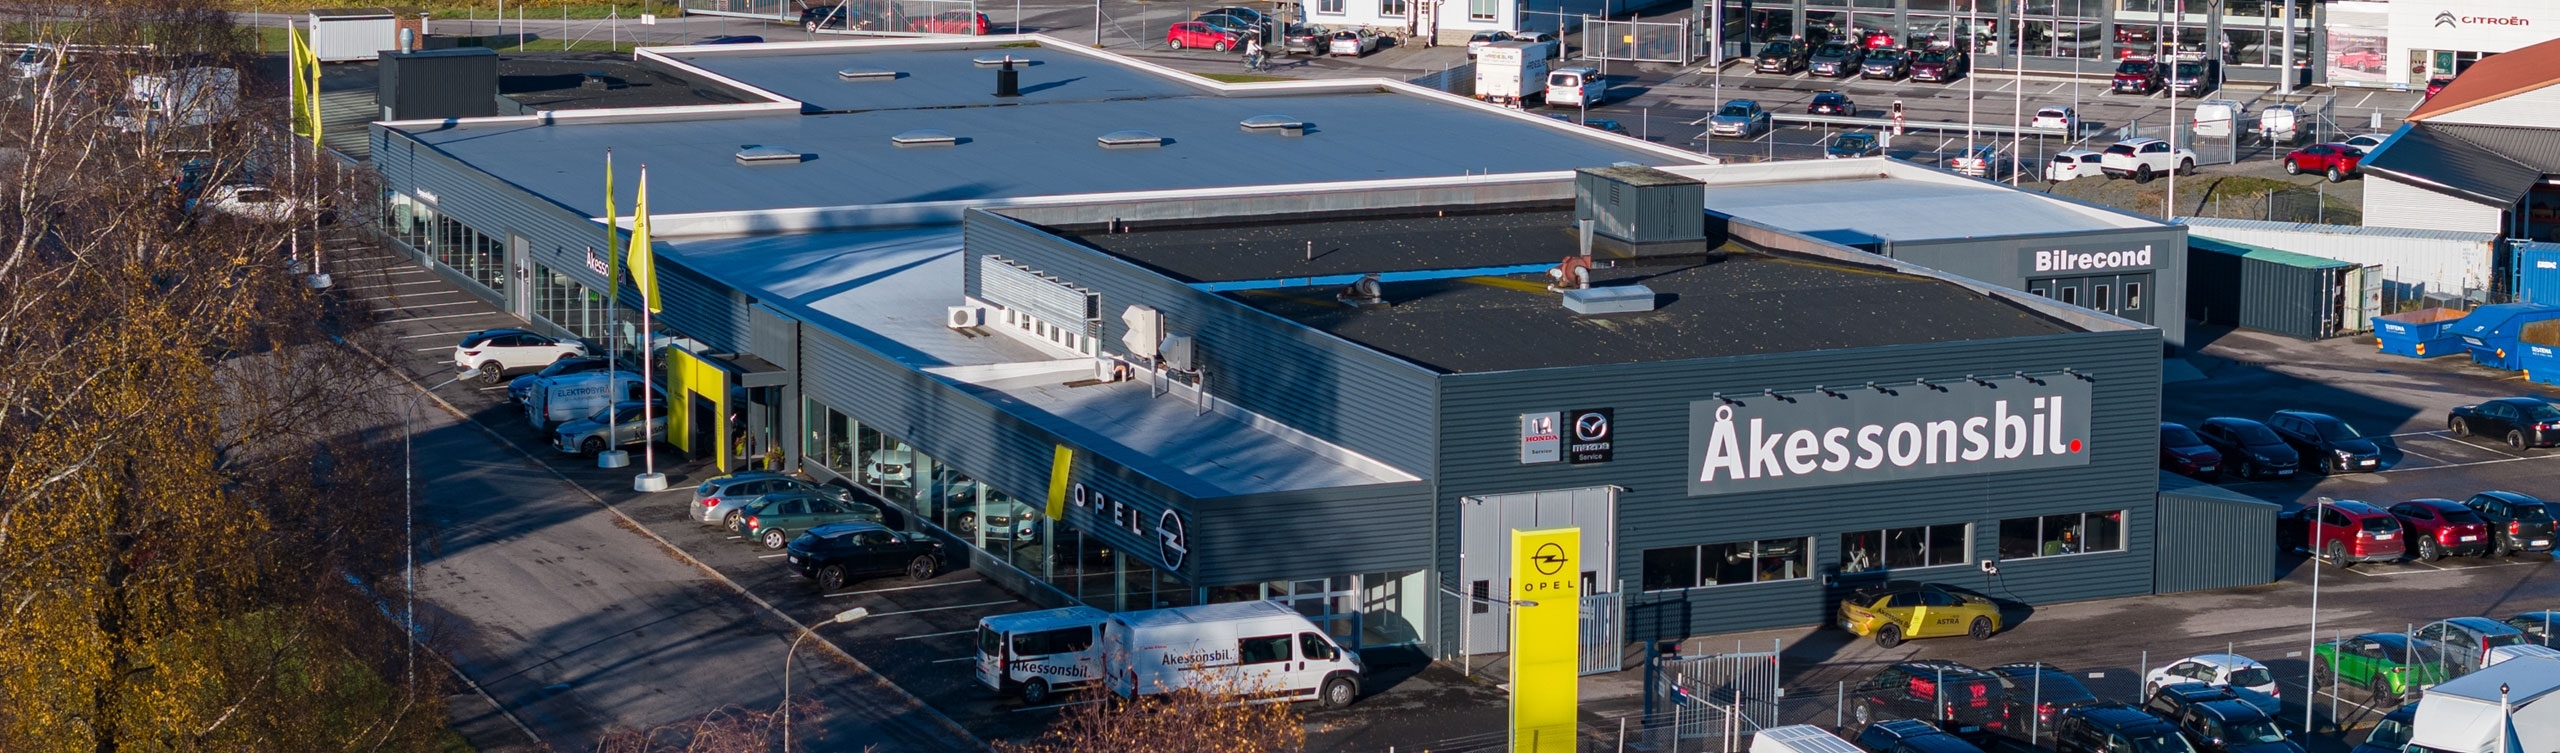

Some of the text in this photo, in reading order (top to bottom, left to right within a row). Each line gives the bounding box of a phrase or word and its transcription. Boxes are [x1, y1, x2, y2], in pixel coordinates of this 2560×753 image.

[2035, 244, 2152, 271] Bilrecond
[558, 385, 615, 398] ELEKTROBYRÅ
[1526, 434, 1559, 443] HONDA
[1579, 453, 1603, 461] Service
[1074, 482, 1142, 536] OPEL
[1524, 580, 1575, 592] OPEL
[1936, 617, 1960, 625] ASTRA
